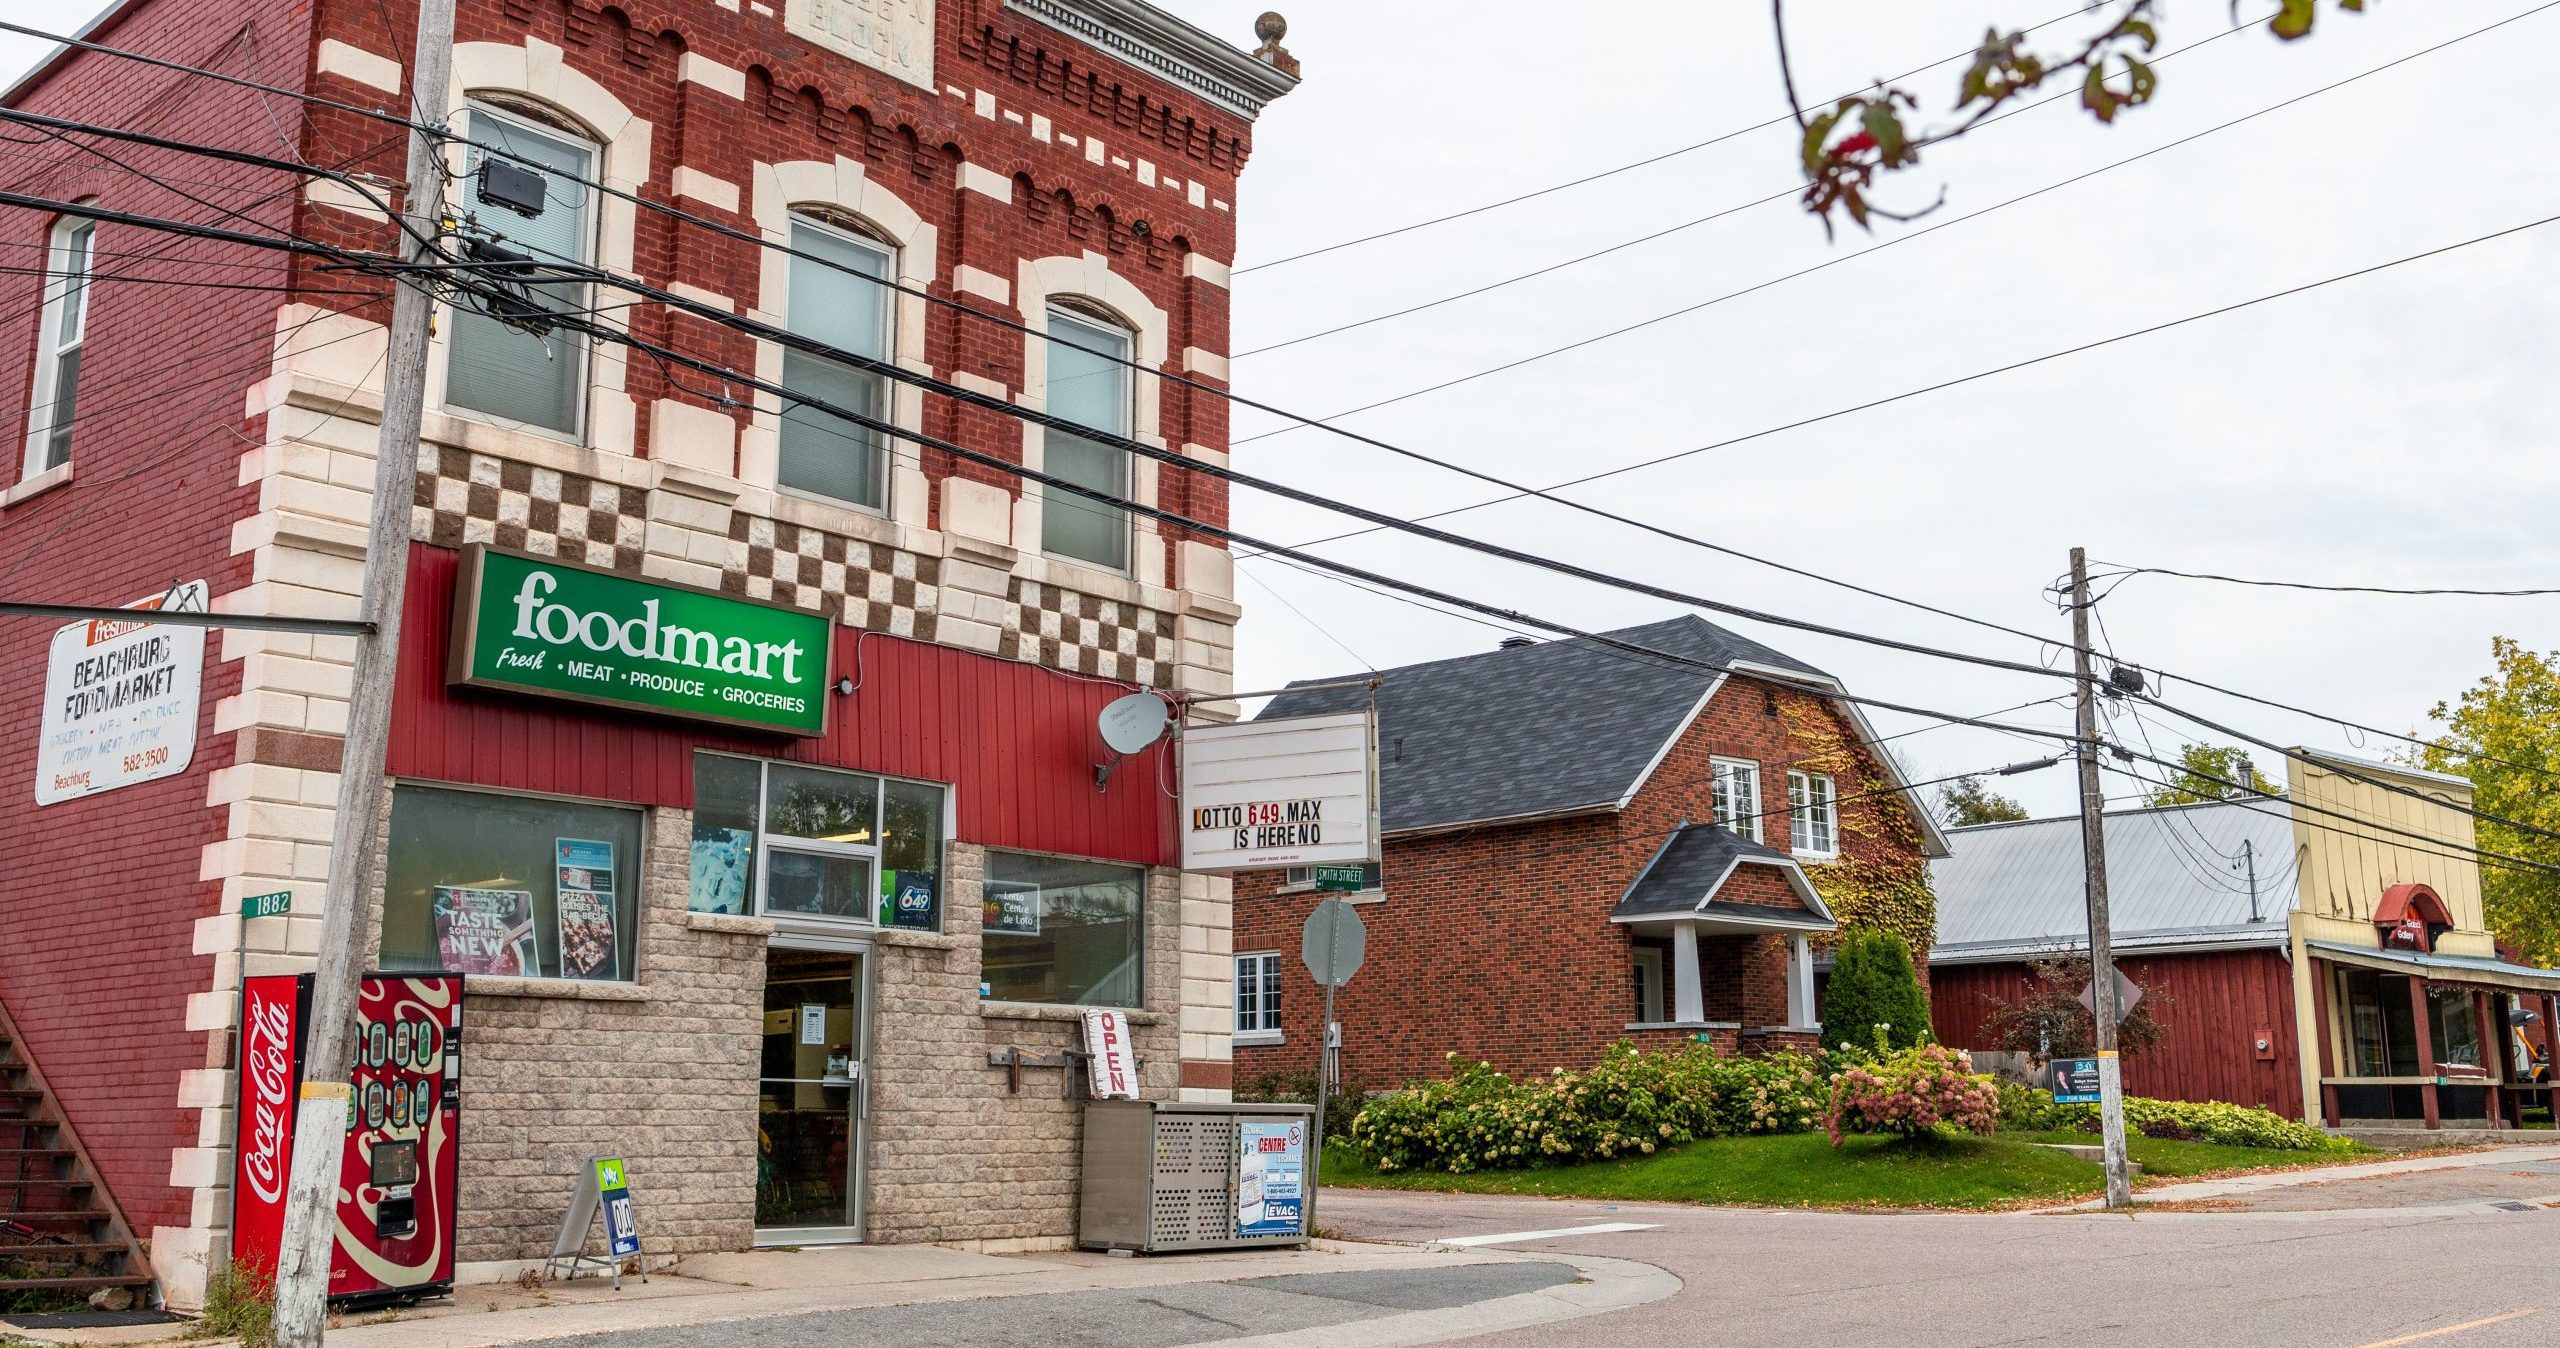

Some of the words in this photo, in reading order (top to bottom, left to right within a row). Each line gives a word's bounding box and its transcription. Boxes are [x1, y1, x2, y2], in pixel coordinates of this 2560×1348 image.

[512, 570, 804, 684] foodmart
[496, 647, 546, 670] Fresh
[567, 660, 615, 682] MEAT
[630, 671, 705, 697] PRODUCE
[722, 686, 806, 713] GROCERIES
[123, 745, 170, 774] 582-3500
[54, 769, 92, 791] Beachburg
[1193, 806, 1242, 829] LOTTO
[1287, 800, 1321, 822] MAX
[1233, 828, 1248, 849] IS
[1318, 867, 1338, 881] SMITH
[1339, 868, 1362, 882] STREET
[257, 892, 289, 916] 1882
[561, 892, 586, 902] PIZZA
[1004, 890, 1025, 902] Lotto
[593, 903, 609, 913] THE
[1003, 902, 1030, 914] Centre
[445, 909, 504, 930] TASTE
[1003, 914, 1013, 924] de
[1015, 915, 1033, 925] Loto
[448, 925, 505, 938] SOMETHING
[449, 934, 505, 957] NEW
[1101, 1012, 1126, 1092] OPEN
[244, 989, 290, 1205] Coca-Cola
[1257, 1136, 1287, 1154] CENTRE
